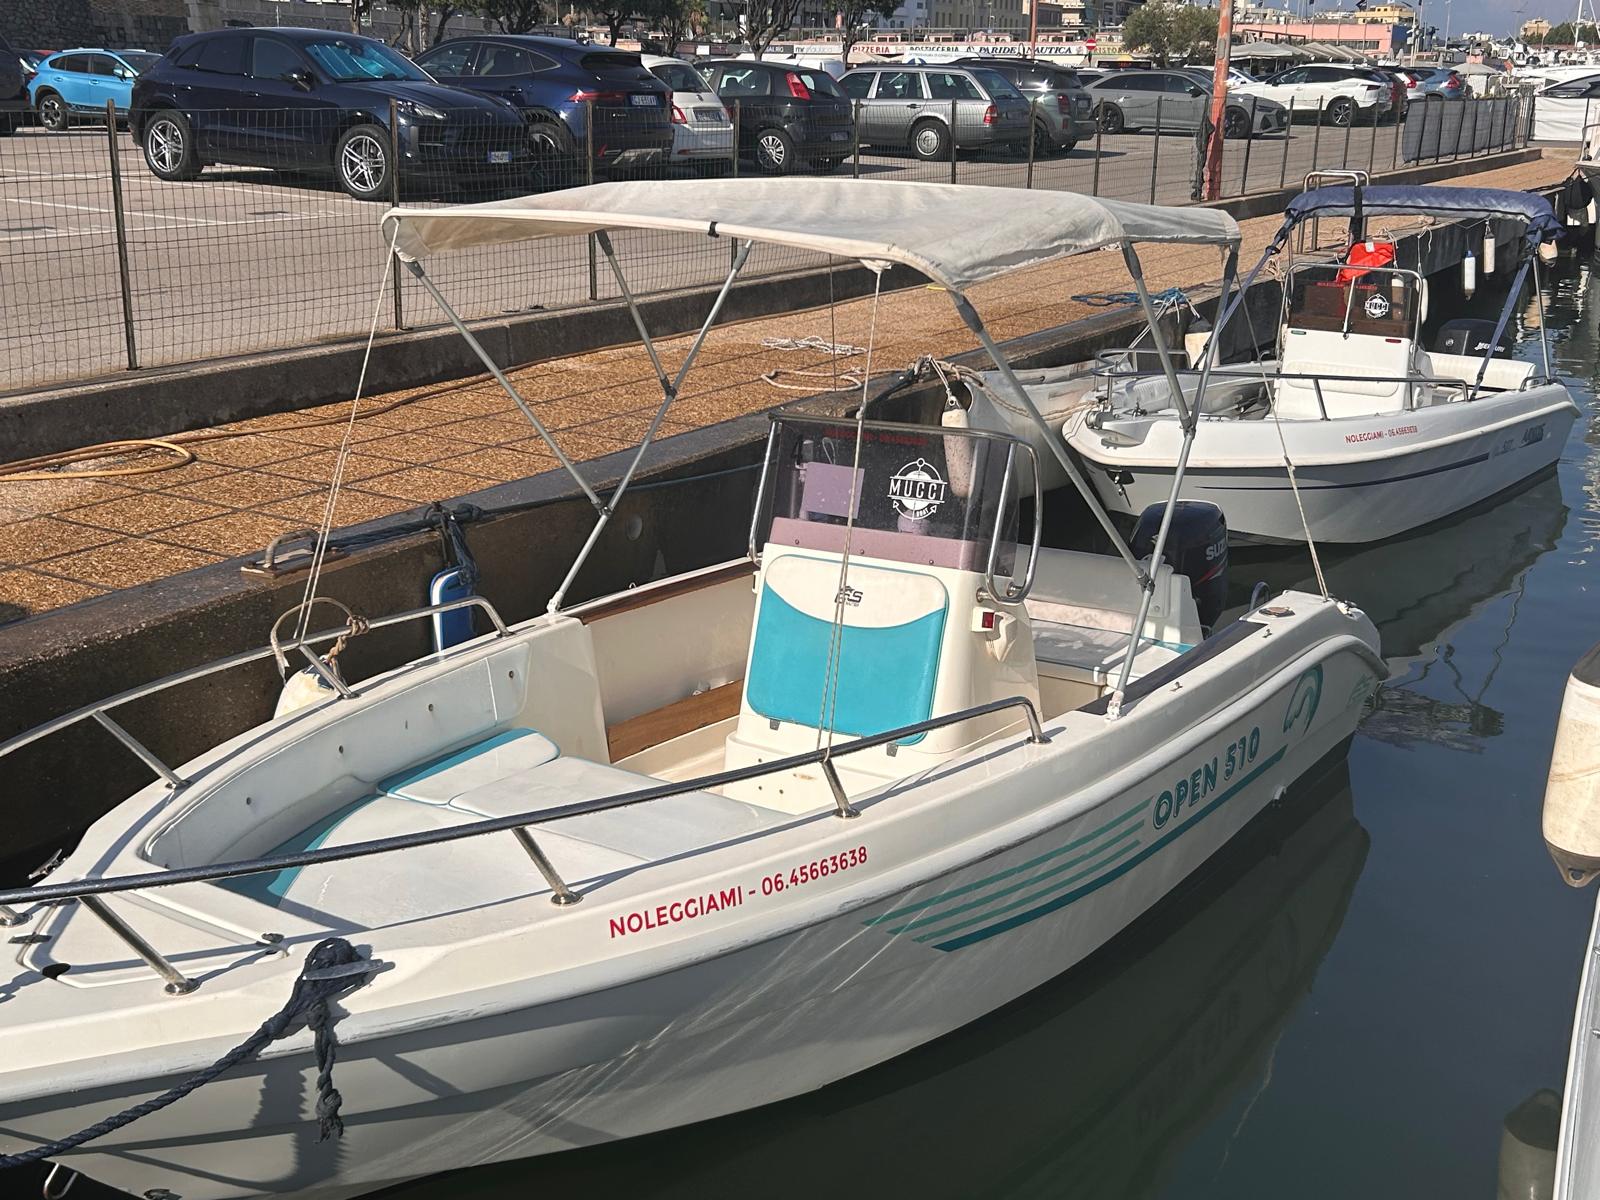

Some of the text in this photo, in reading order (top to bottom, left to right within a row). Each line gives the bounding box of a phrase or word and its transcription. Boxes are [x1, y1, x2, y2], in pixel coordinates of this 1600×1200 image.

[852, 46, 890, 54] PIZZERIA
[979, 46, 1072, 54] PARIDE NAUTICA
[1344, 430, 1384, 444] NOLEGGIAMI
[889, 478, 946, 501] MUCCI
[1153, 726, 1260, 830] OPEN 510
[608, 885, 744, 939] NOLEGGIAMI
[761, 846, 868, 897] 06.45663638
